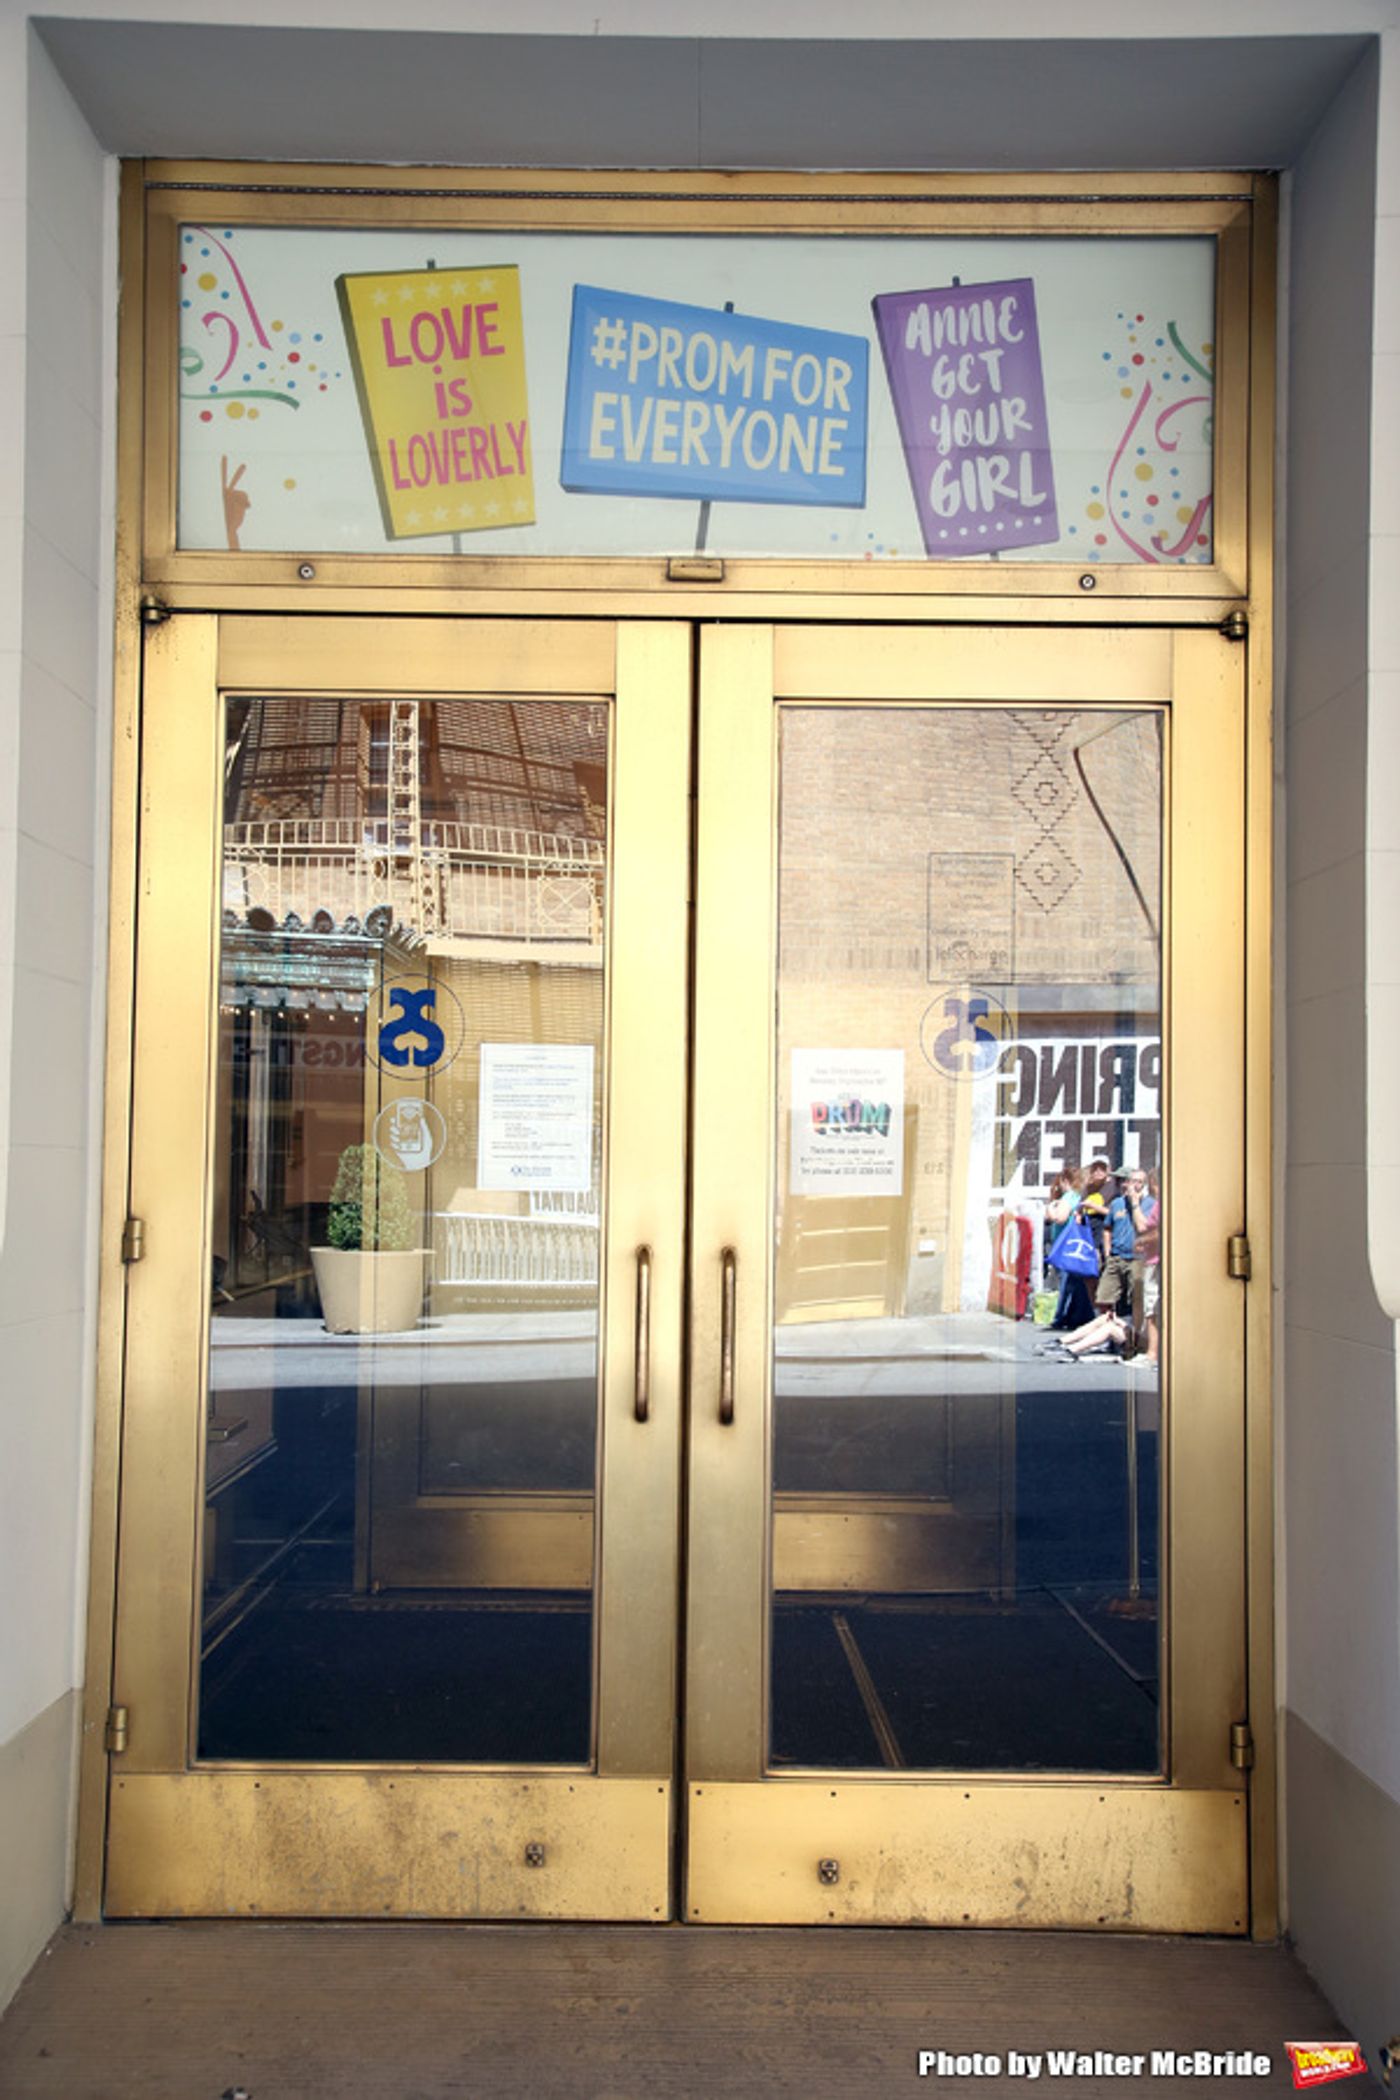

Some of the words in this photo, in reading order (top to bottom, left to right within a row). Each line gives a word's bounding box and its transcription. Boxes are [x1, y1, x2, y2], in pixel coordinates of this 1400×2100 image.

[381, 302, 505, 369] LOVE
[905, 296, 1024, 356] ANNIE
[590, 316, 754, 398] #PROM
[765, 350, 853, 412] FOR
[931, 350, 1004, 398] GET
[388, 420, 527, 491] LOVERLY
[589, 392, 849, 478] EVERYONE
[930, 451, 1047, 518] GIRL
